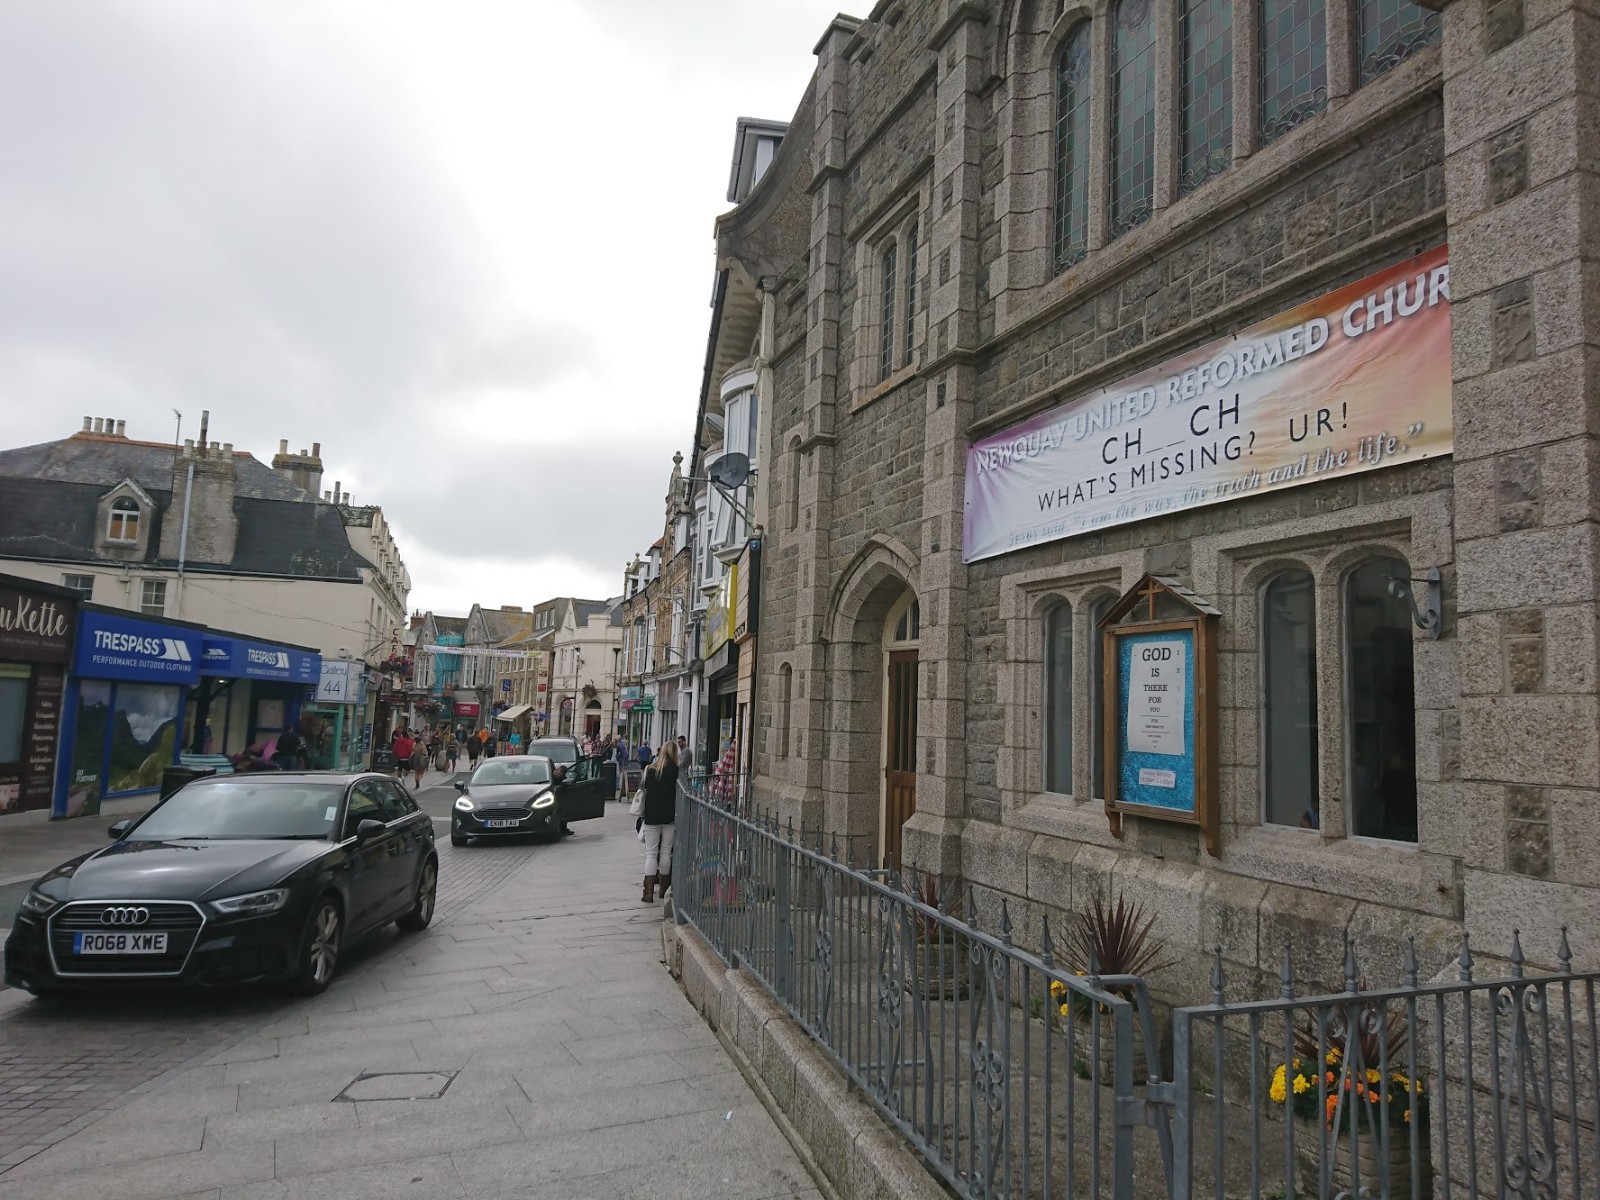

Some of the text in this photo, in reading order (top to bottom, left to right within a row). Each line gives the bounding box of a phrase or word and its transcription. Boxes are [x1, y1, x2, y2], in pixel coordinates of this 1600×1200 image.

[974, 419, 1068, 475] NEWQUAY
[1074, 386, 1157, 441] UNITED
[1165, 317, 1330, 406] REFORMED
[1038, 472, 1117, 512] WHAT'S
[1131, 430, 1256, 488] MISSING?
[1182, 485, 1207, 504] the
[1213, 468, 1261, 497] truth
[1267, 453, 1309, 484] and
[1314, 447, 1348, 474] the
[94, 630, 160, 656] TRESPASS
[247, 648, 277, 666] TRESPASS
[1142, 647, 1172, 661] GOD
[92, 654, 192, 672] PERFORMANCE OUTDOOR CLOTHING
[1151, 667, 1160, 678] IS
[324, 680, 341, 695] 44
[1143, 684, 1168, 692] THERE
[1148, 696, 1162, 704] FOR
[131, 934, 165, 950] XWE
